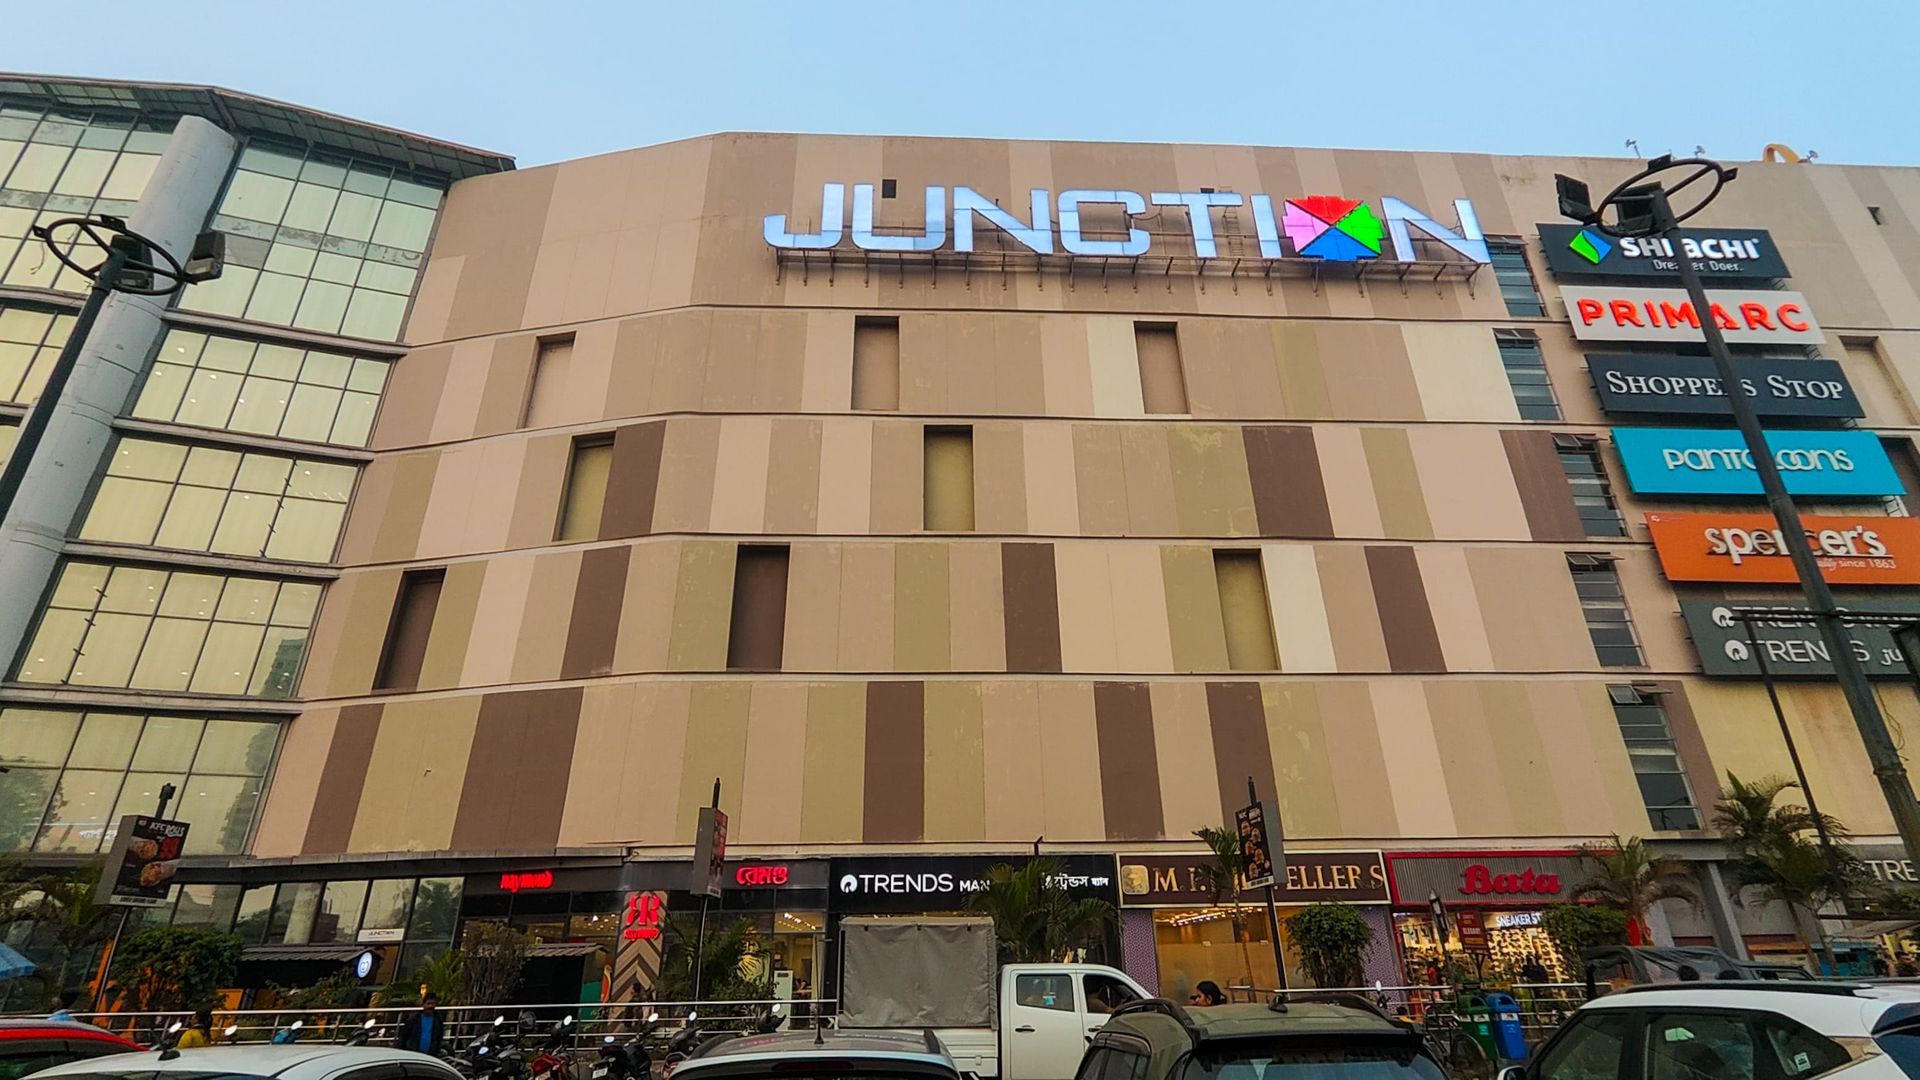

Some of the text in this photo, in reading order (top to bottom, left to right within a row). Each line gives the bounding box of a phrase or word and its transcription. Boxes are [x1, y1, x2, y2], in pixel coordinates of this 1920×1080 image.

[1577, 298, 1810, 332] PRIMARC
[1606, 371, 1843, 400] SHOPPES STOP
[1867, 558, 1897, 570] 1863
[1745, 640, 1871, 663] RENS
[859, 873, 954, 893] TRENDS
[1460, 864, 1564, 895] Bata
[1496, 913, 1532, 928] SNEAKER
